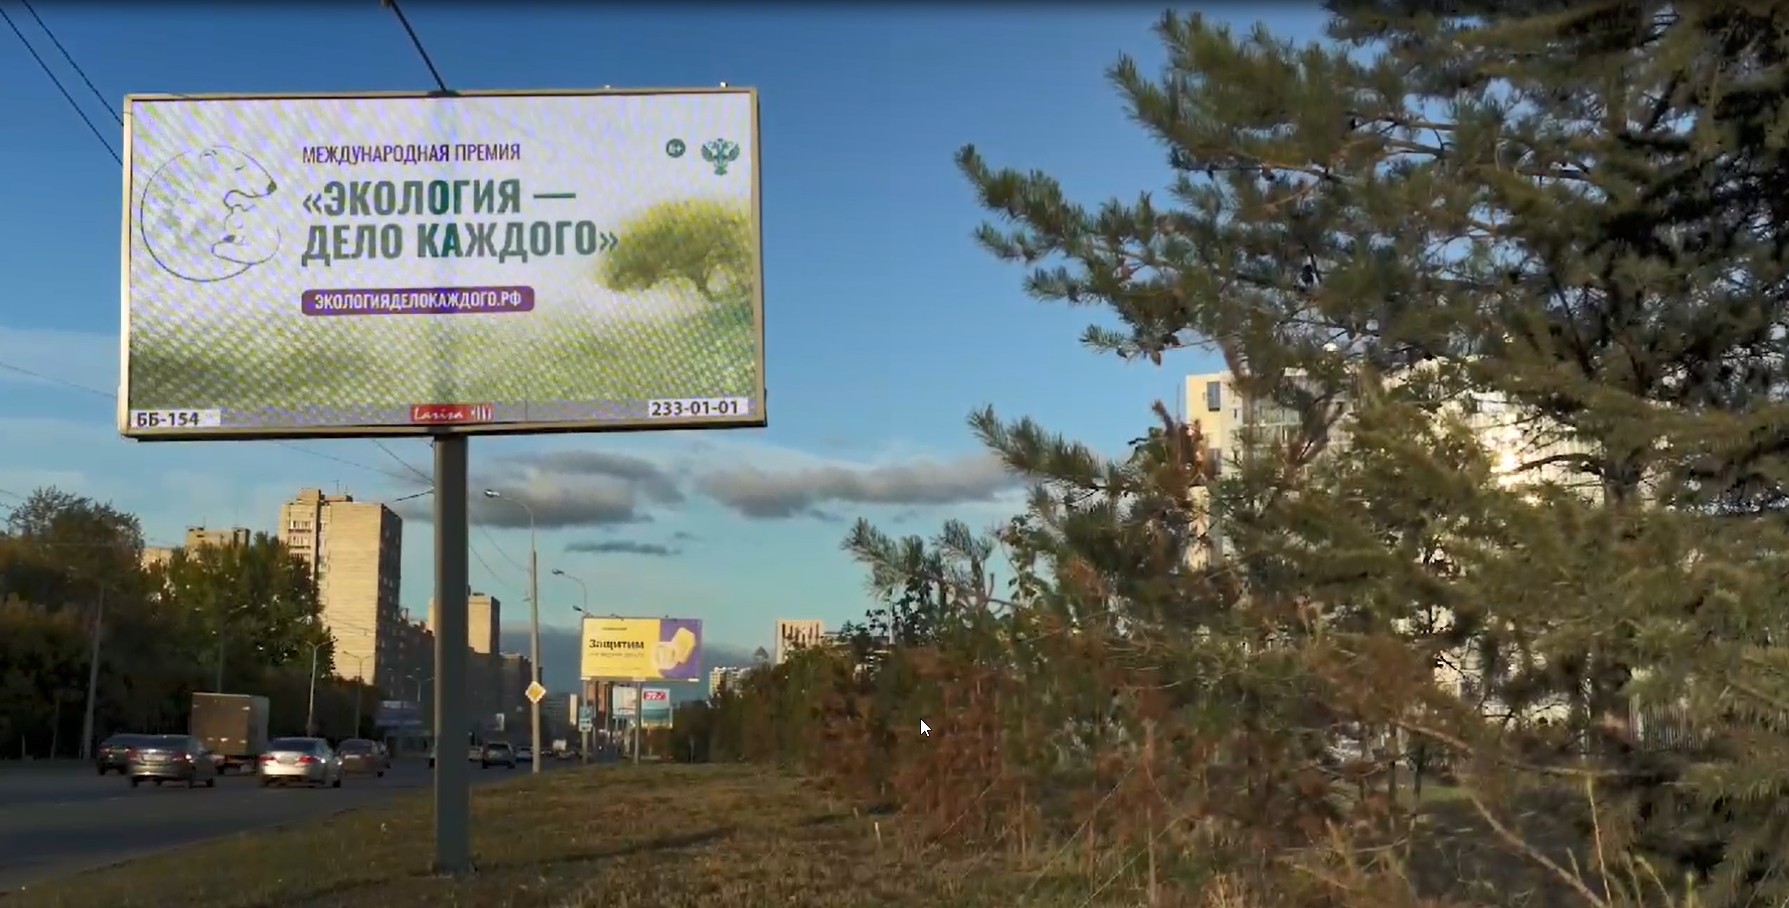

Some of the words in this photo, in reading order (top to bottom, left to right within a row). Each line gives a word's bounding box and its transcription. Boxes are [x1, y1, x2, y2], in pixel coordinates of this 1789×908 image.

[302, 144, 450, 165] МЕЖДУНАРОДНАЯ
[455, 143, 521, 161] ПРЕМИЯ
[302, 178, 521, 216] «ЭКОЛОГИЯ
[301, 223, 404, 267] ДЕЛО
[416, 219, 619, 264] КАЖДОГО»
[314, 289, 522, 311] ЭКОЛОГИЯДЕЛОКАЖДОГО.РФ
[137, 411, 199, 427] ББ-154
[651, 400, 738, 416] 233-01-01
[589, 639, 645, 650] Защитим
